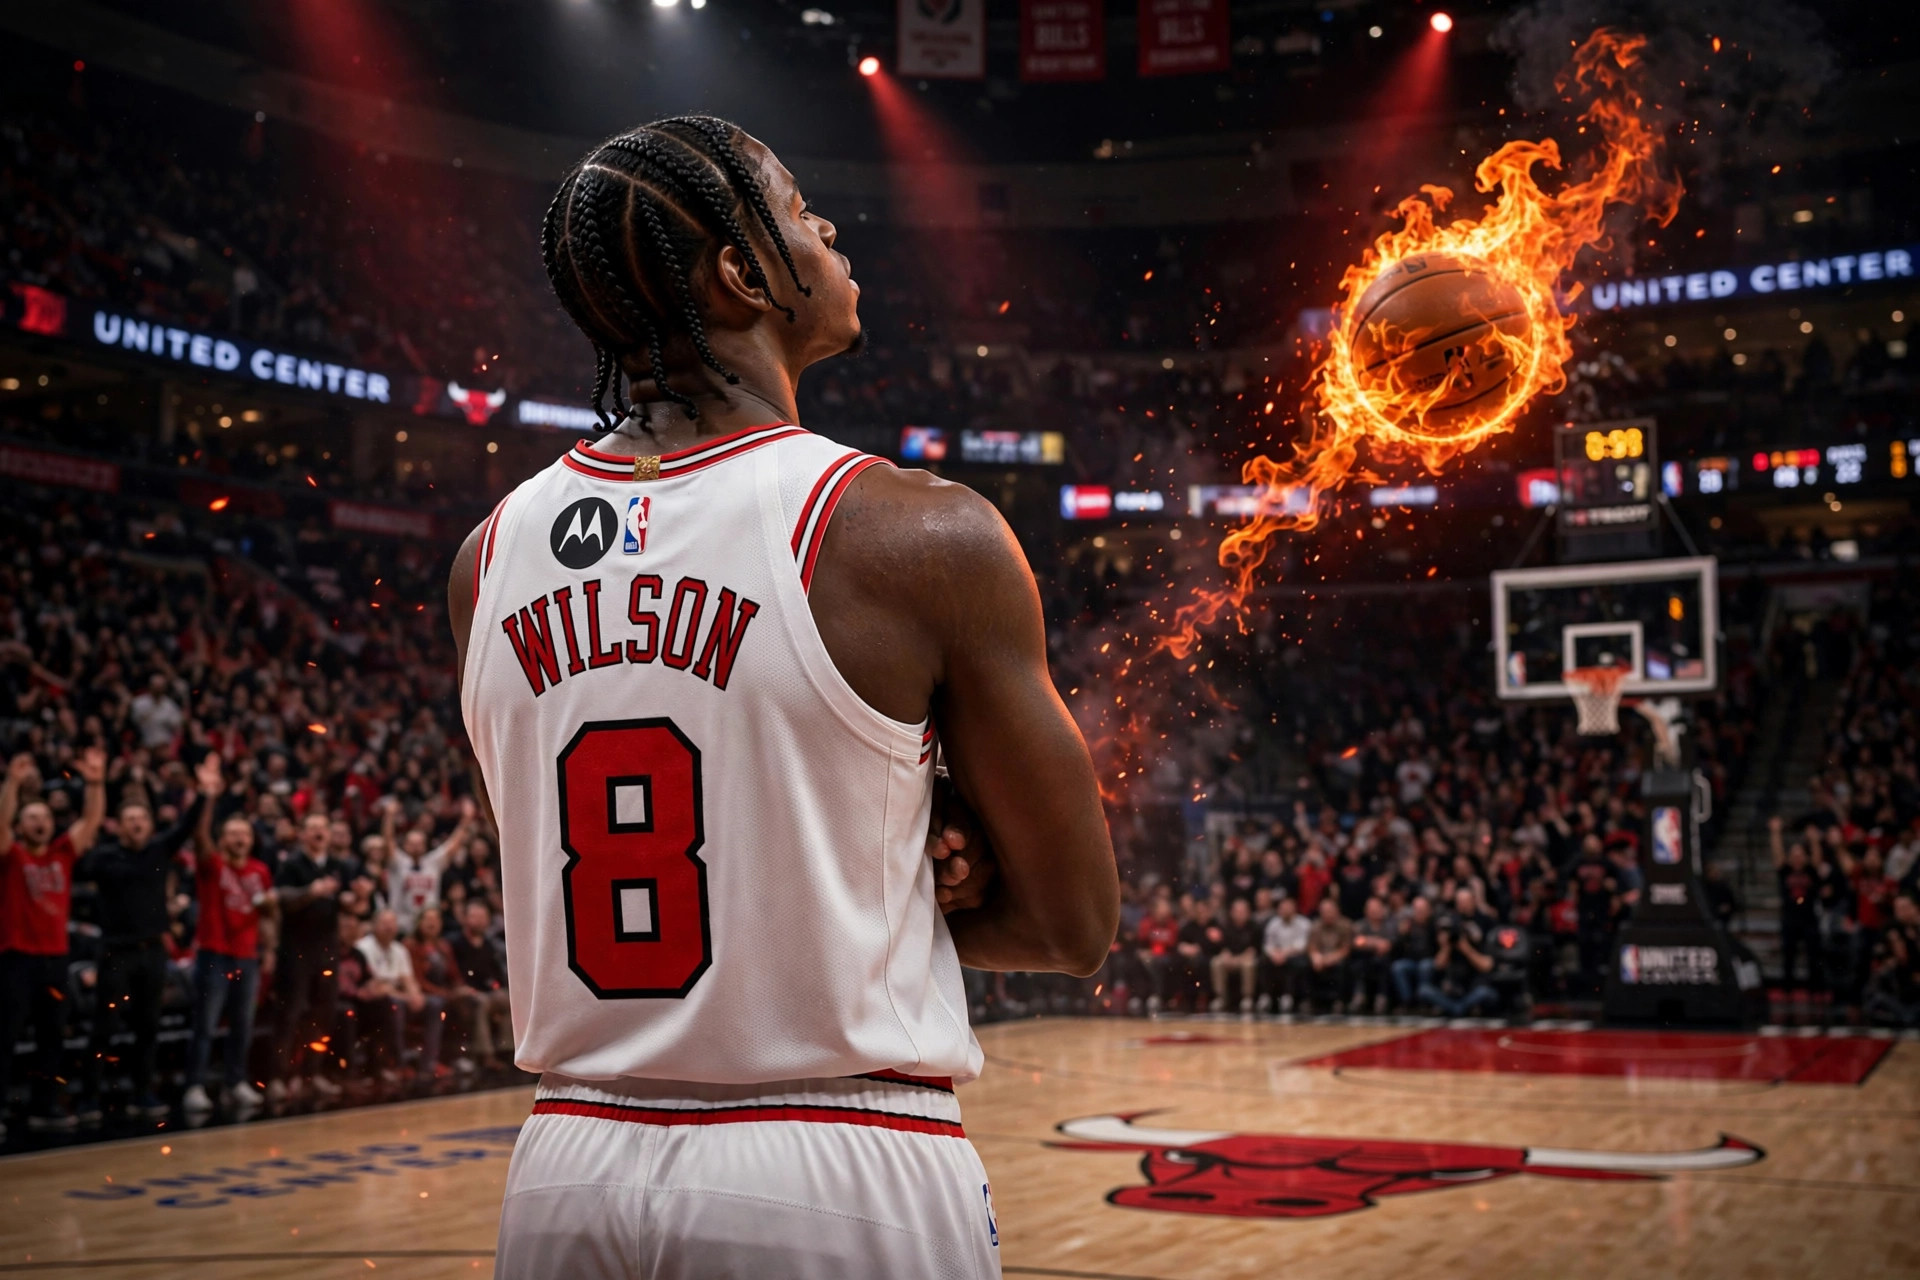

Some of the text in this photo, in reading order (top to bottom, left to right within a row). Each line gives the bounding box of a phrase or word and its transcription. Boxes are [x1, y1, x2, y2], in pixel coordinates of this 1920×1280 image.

[1592, 249, 1913, 311] UNITED CENTER
[93, 310, 391, 404] UNITED CENTER
[501, 574, 760, 697] WILSON
[556, 717, 713, 1000] 8
